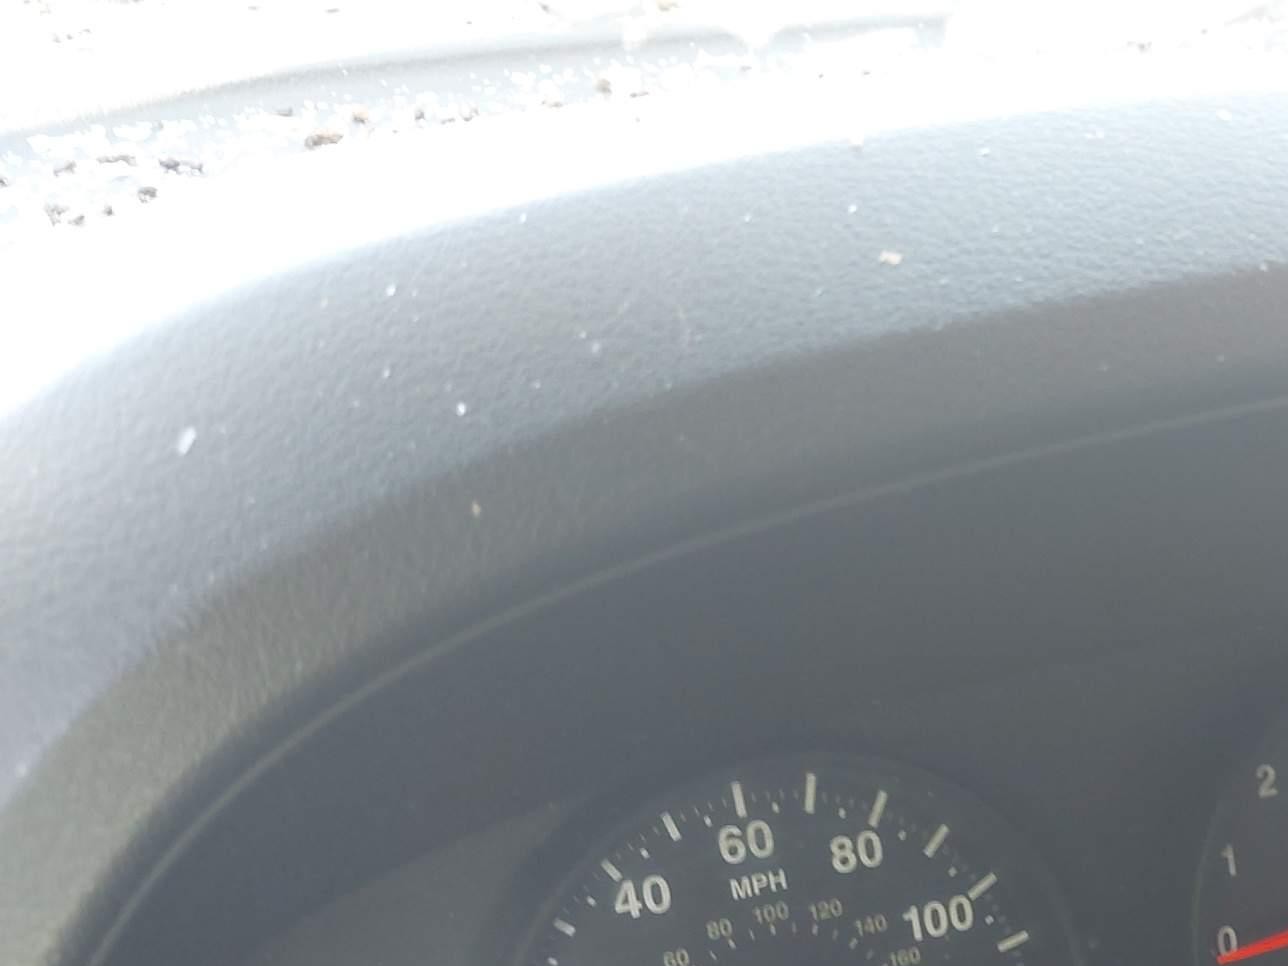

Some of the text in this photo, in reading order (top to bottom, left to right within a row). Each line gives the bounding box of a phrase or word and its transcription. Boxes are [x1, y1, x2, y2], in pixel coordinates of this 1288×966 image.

[1256, 764, 1278, 799] 2
[718, 820, 775, 864] 60
[829, 830, 883, 873] 80
[1221, 845, 1237, 876] 1
[614, 875, 671, 919] 40
[730, 869, 788, 901] MPH
[753, 902, 790, 924] 100
[809, 899, 843, 922] 120
[855, 914, 888, 937] 140
[903, 894, 974, 942] 100
[706, 918, 733, 940] 80
[1217, 925, 1238, 957] 0
